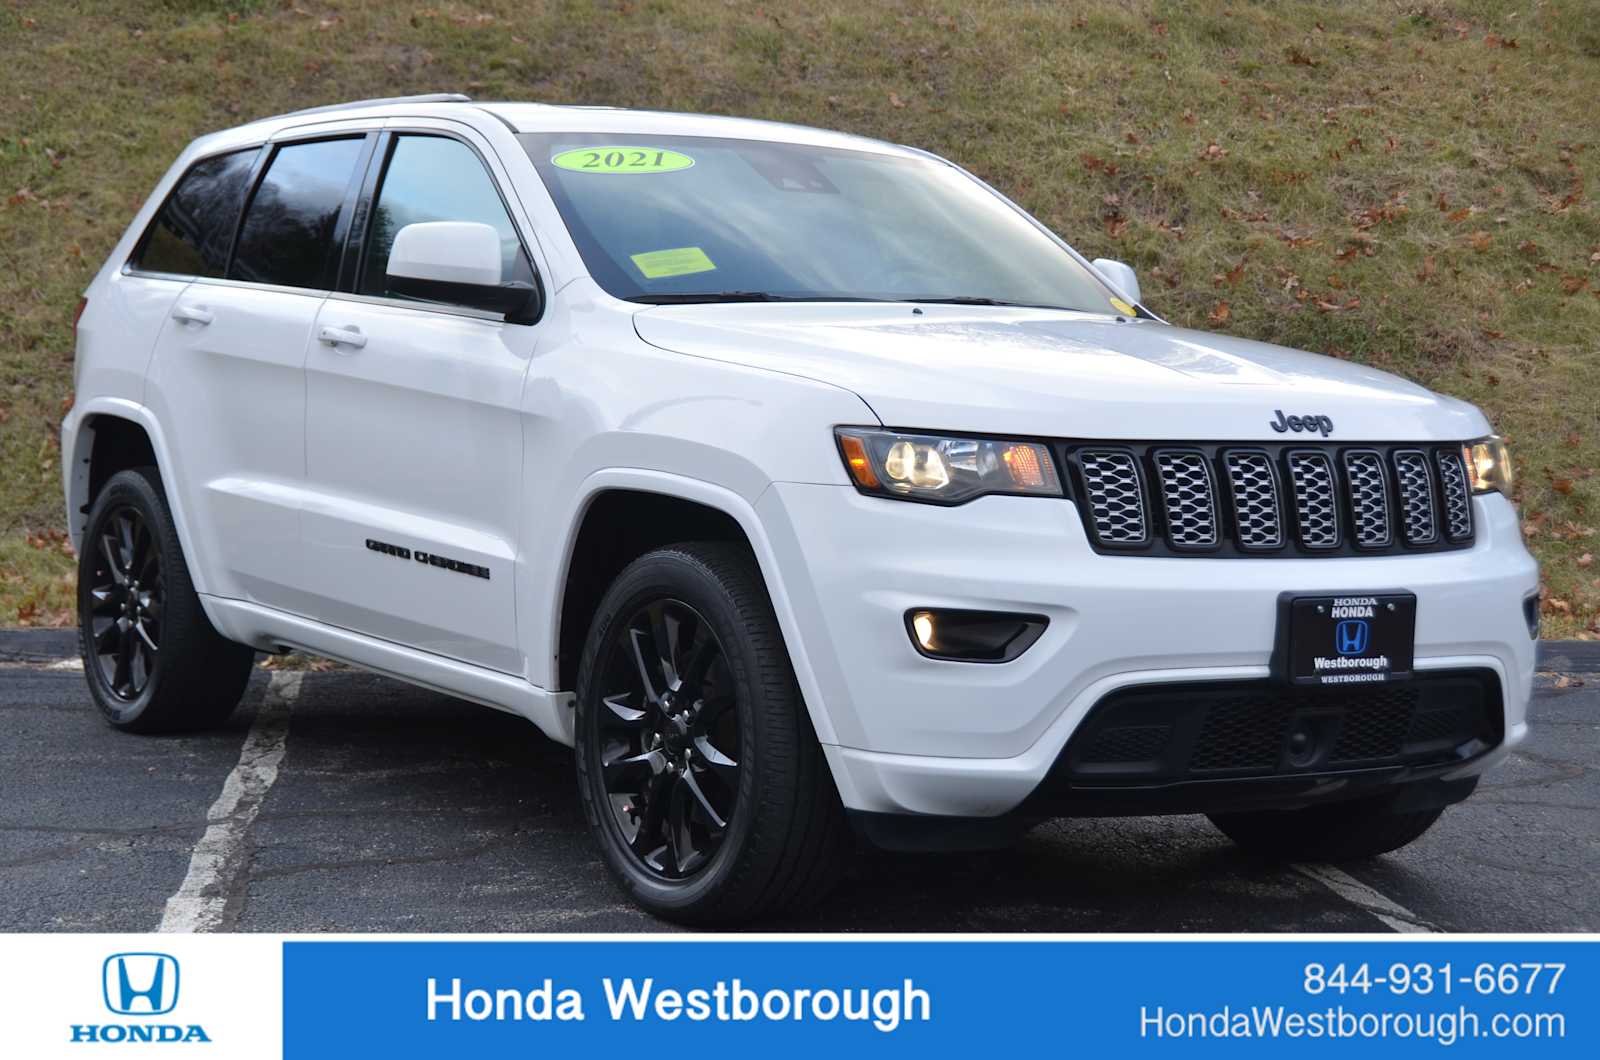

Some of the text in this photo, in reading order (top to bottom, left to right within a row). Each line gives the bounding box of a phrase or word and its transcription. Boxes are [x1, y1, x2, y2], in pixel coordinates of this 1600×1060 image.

[582, 151, 665, 168] 2021
[1270, 409, 1334, 438] Jeep
[365, 538, 490, 580] GRAND CHEROKEE
[1332, 598, 1379, 606] HONDA
[1331, 606, 1374, 618] HONDA
[1314, 655, 1388, 669] Westborough
[1321, 673, 1385, 684] WESTBOROUGH
